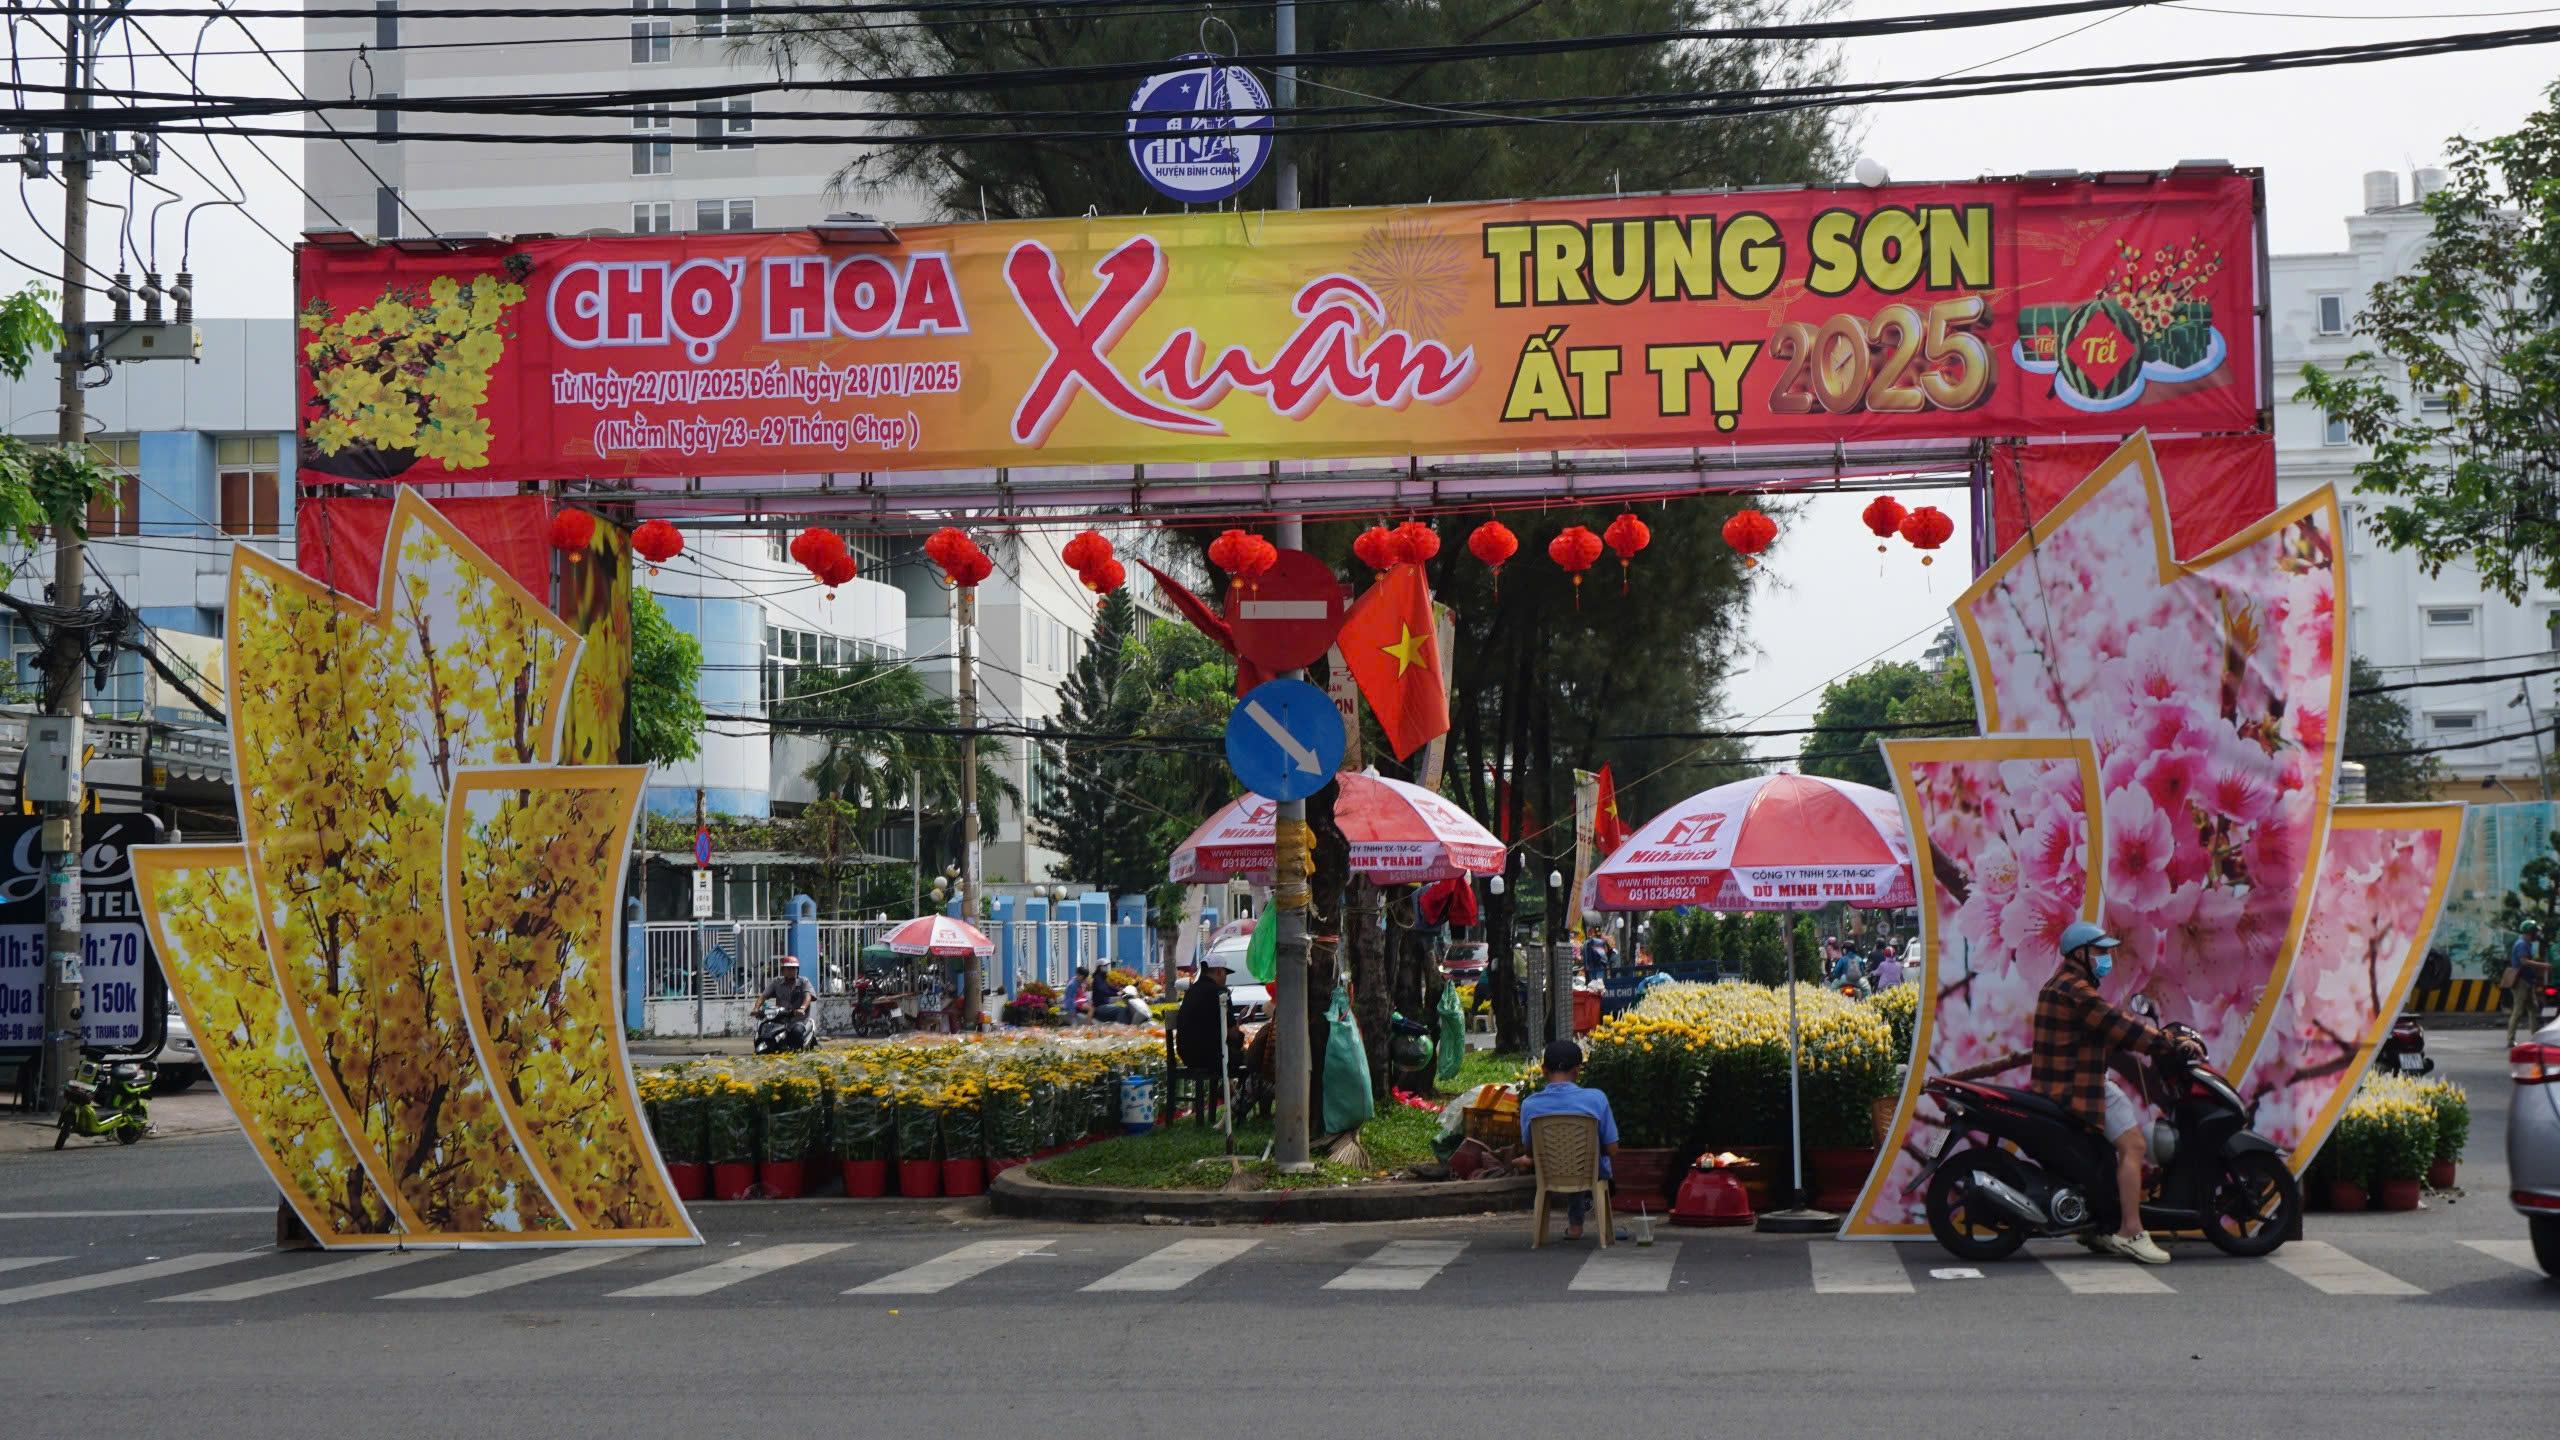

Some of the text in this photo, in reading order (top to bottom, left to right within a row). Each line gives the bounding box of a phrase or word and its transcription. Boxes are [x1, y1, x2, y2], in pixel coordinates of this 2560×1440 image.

[1156, 164, 1240, 178] HUYỆN BÌNH CHÁNH
[1483, 203, 1994, 308] TRUNG SƠN
[547, 250, 971, 364] CHỢ HOA
[1003, 235, 1482, 448] Xuân
[1767, 296, 1997, 415] 2025
[2082, 331, 2118, 364] Tết
[552, 359, 961, 410] Từ Ngày 22/01/2025 Đến Ngày 28/01/2025
[1500, 324, 1765, 434] ẤT TỴ
[668, 415, 721, 456] Ngày
[788, 411, 848, 451] Tháng
[1628, 886, 1697, 902] 0918284924
[1753, 881, 1773, 898] DÙ
[1778, 883, 1818, 897] MINH
[1822, 879, 1876, 897] THÀNH
[1785, 869, 1797, 880] TY
[1799, 869, 1824, 879] TNHH
[91, 982, 137, 1014] 150k
